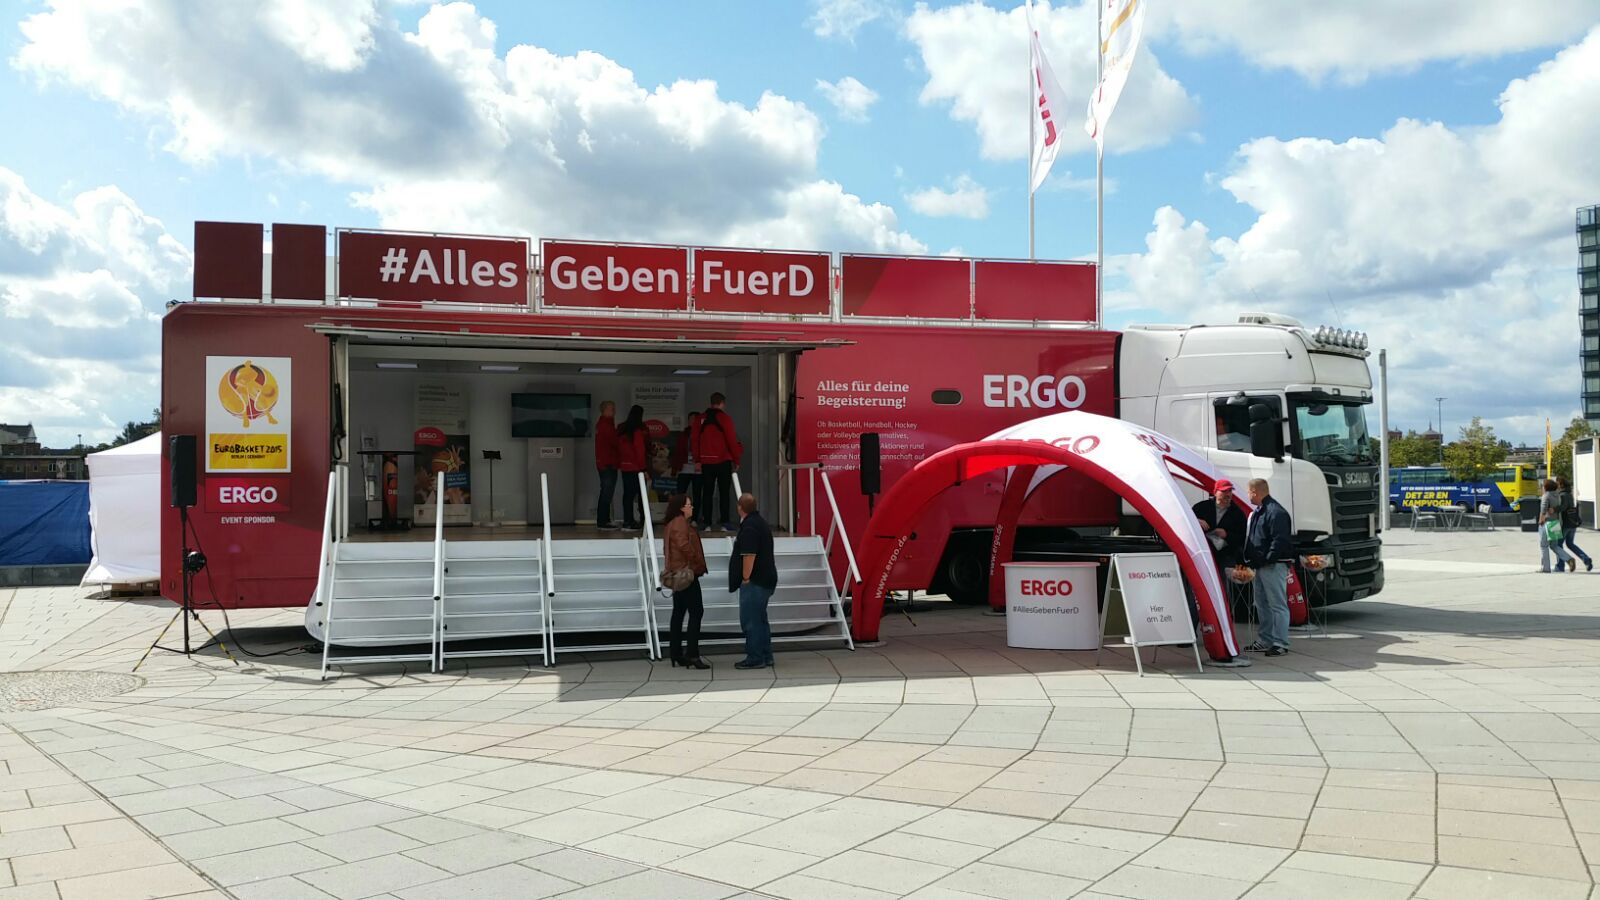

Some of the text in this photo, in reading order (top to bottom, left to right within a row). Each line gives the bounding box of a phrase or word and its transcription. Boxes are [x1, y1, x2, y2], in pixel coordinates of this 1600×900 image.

[380, 247, 815, 297] #Alles Geben FuerD
[817, 380, 909, 393] Alles für deine
[983, 374, 1087, 409] ERGO
[817, 395, 907, 409] Begeisterung!
[828, 421, 862, 429] Basketball,
[863, 421, 893, 429] Handball,
[894, 421, 917, 430] Hockey
[833, 432, 861, 440] Volleyba
[265, 445, 282, 454] 2015
[880, 443, 908, 451] Aktionen
[909, 443, 925, 451] rund
[219, 486, 278, 504] ERGO
[1405, 491, 1448, 499] DET ER EN
[1402, 499, 1453, 507] KAMPVOGN
[221, 516, 276, 524] EVENT SPONSOR
[875, 534, 908, 599] www.ergo.de
[1128, 571, 1171, 579] ERGO-Tickets
[1020, 579, 1073, 596] ERGO
[1012, 605, 1080, 615] #AllesGebenFuerD
[1150, 605, 1164, 613] Hier
[1160, 615, 1172, 623] Zelt
